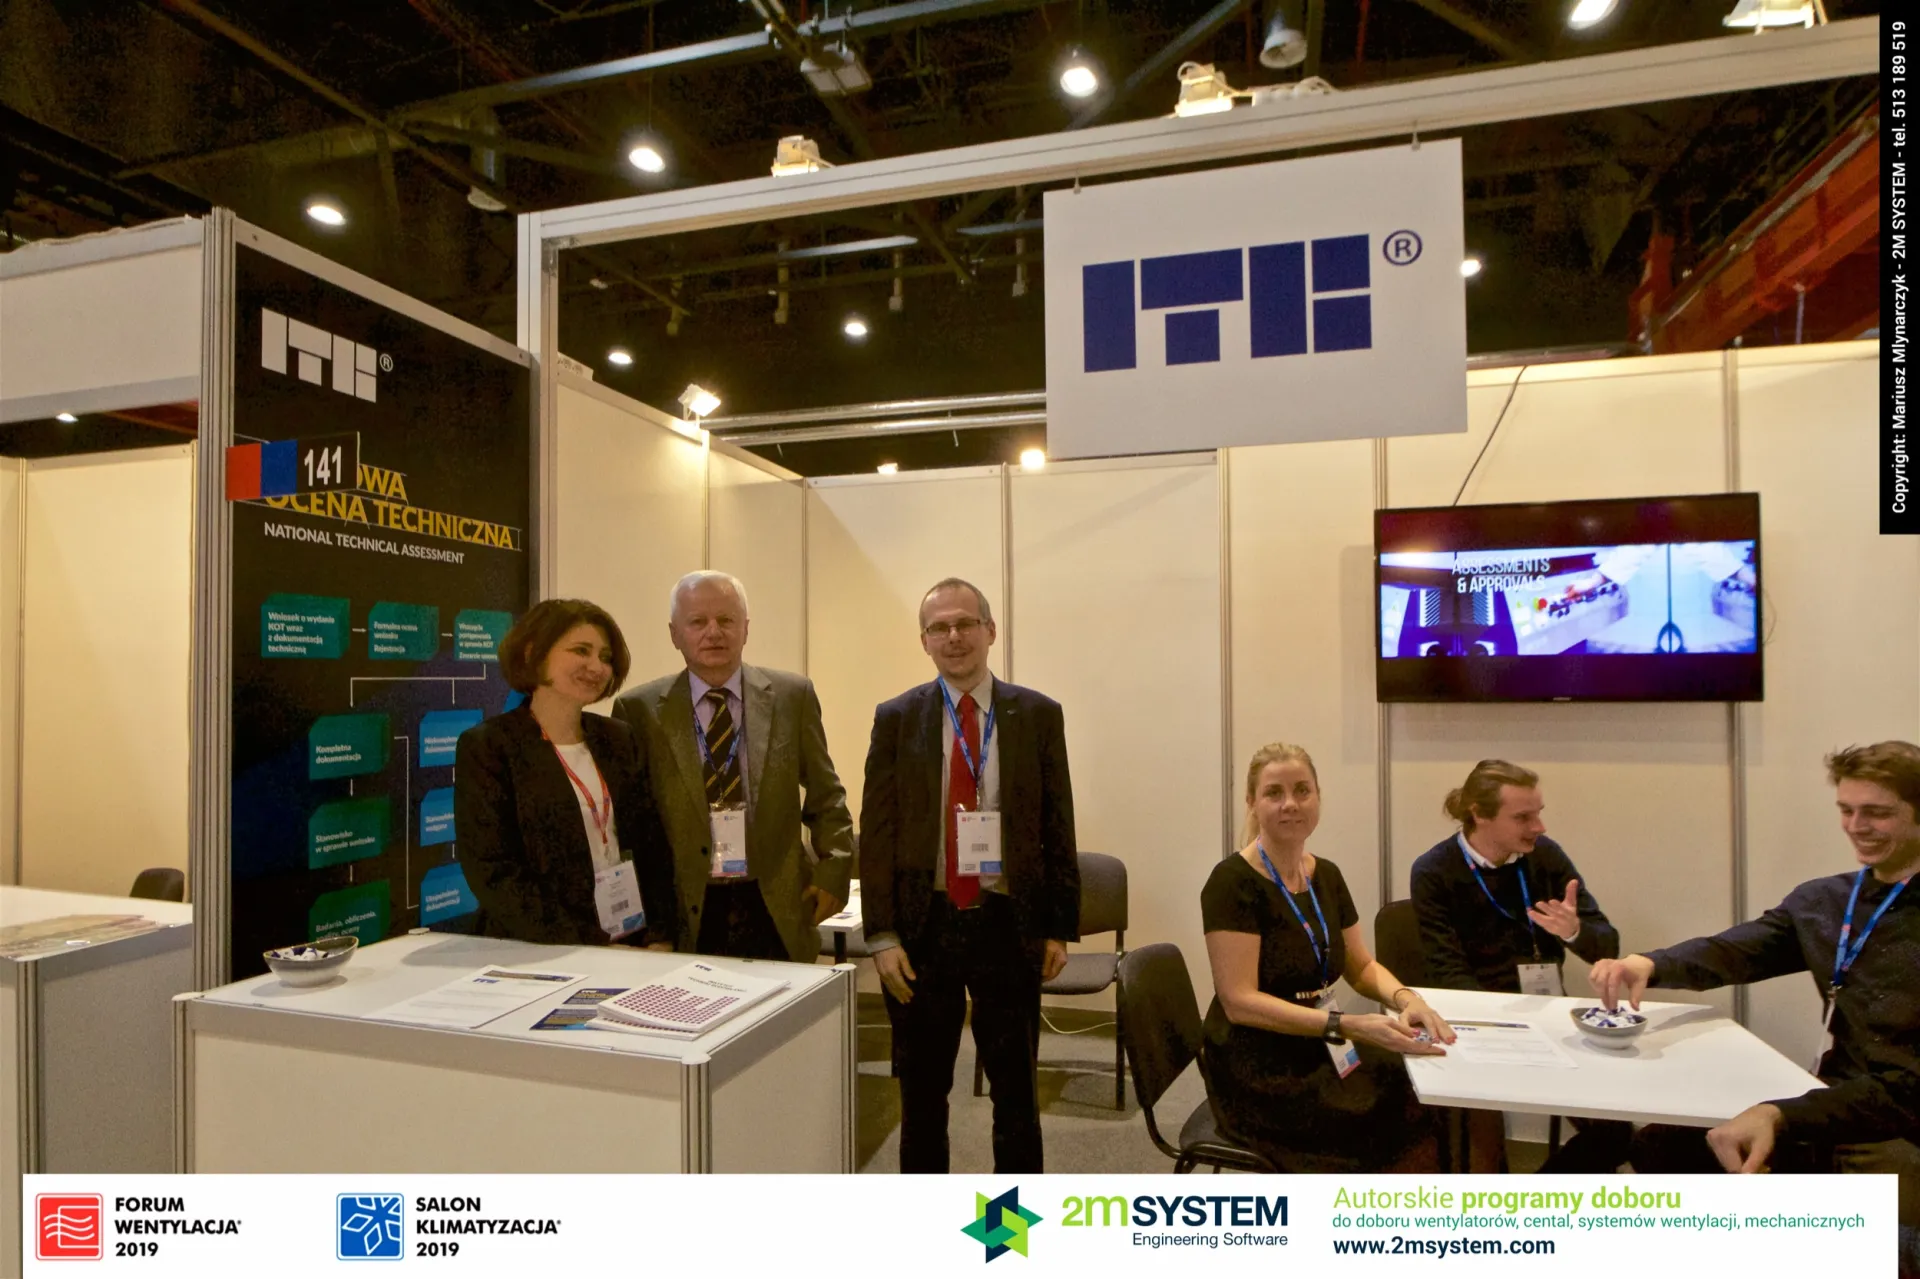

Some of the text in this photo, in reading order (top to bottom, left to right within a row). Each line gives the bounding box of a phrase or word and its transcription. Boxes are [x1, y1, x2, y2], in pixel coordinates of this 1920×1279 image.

[304, 445, 342, 487] 141
[373, 499, 514, 550] TECHNICZNA
[264, 521, 465, 565] NATIONAL TECHNICAL ASSESSMENT
[1456, 574, 1547, 594] & APPROVALS
[267, 611, 300, 622] Wniosek
[267, 622, 286, 632] KOT
[315, 743, 352, 755] Kompletna
[315, 752, 362, 765] dokumentacja
